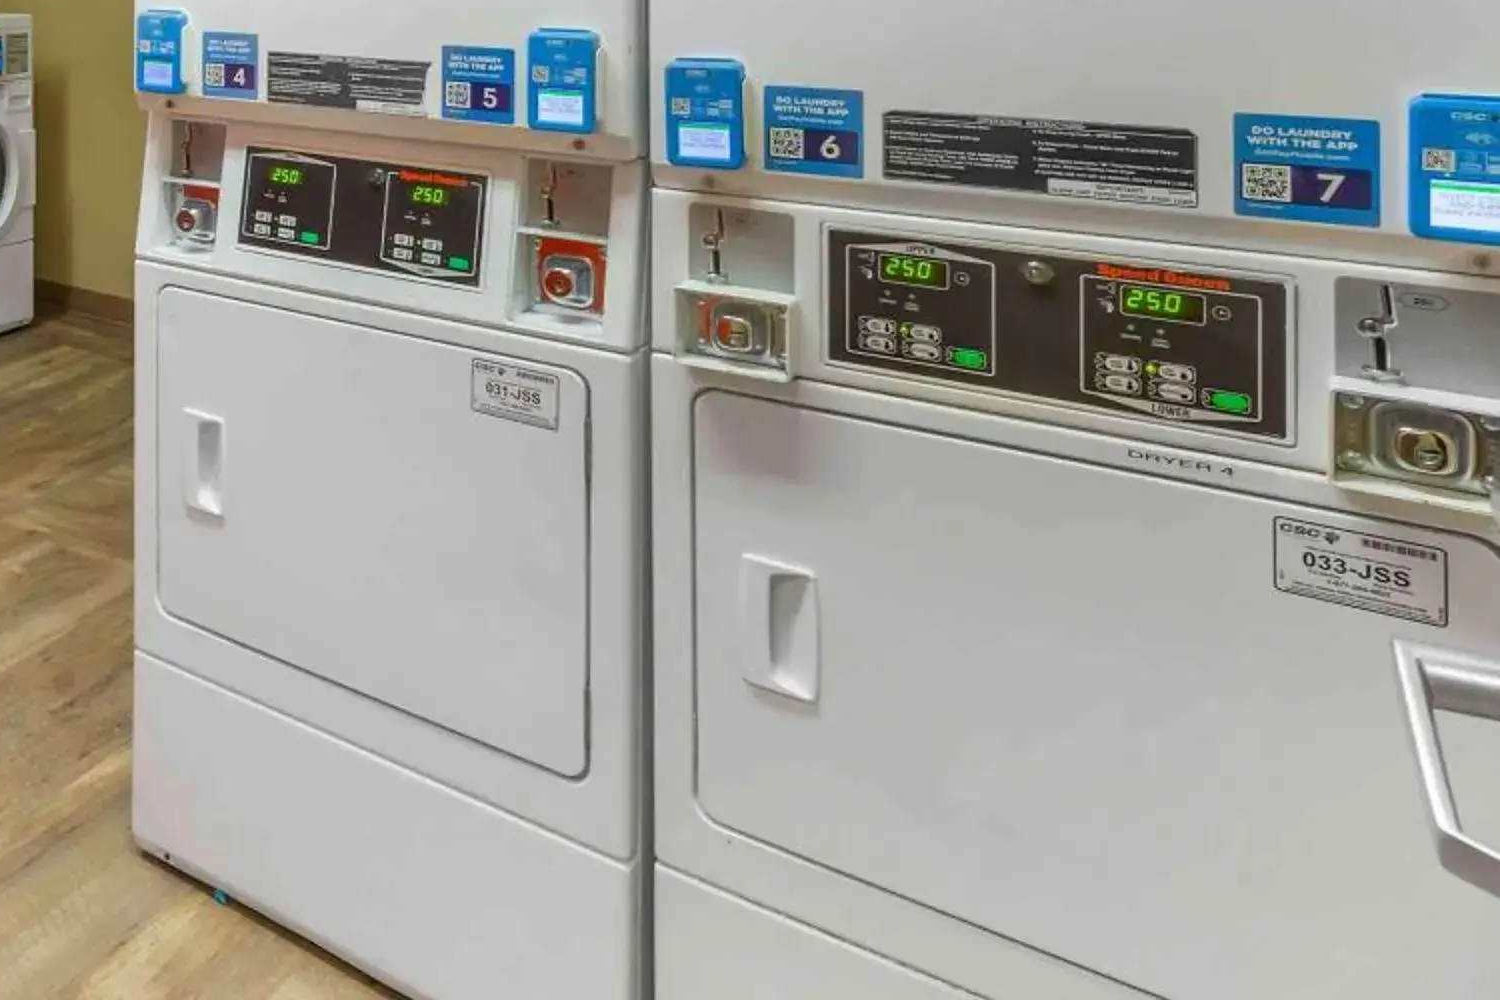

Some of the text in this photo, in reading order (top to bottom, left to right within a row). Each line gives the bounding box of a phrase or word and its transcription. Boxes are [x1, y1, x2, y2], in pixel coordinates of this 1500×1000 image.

[233, 67, 246, 87] 4
[483, 87, 498, 109] 5
[1246, 135, 1359, 152] WITH THE APP
[1251, 125, 1353, 141] DO LAUNDRY
[819, 134, 841, 159] 6
[272, 167, 300, 185] 250
[1316, 172, 1346, 203] 7
[413, 186, 443, 205] 250
[885, 256, 932, 280] 250
[1126, 288, 1182, 314] 250
[1127, 448, 1234, 477] DRYER 4
[1302, 551, 1411, 588] 033-JSS
